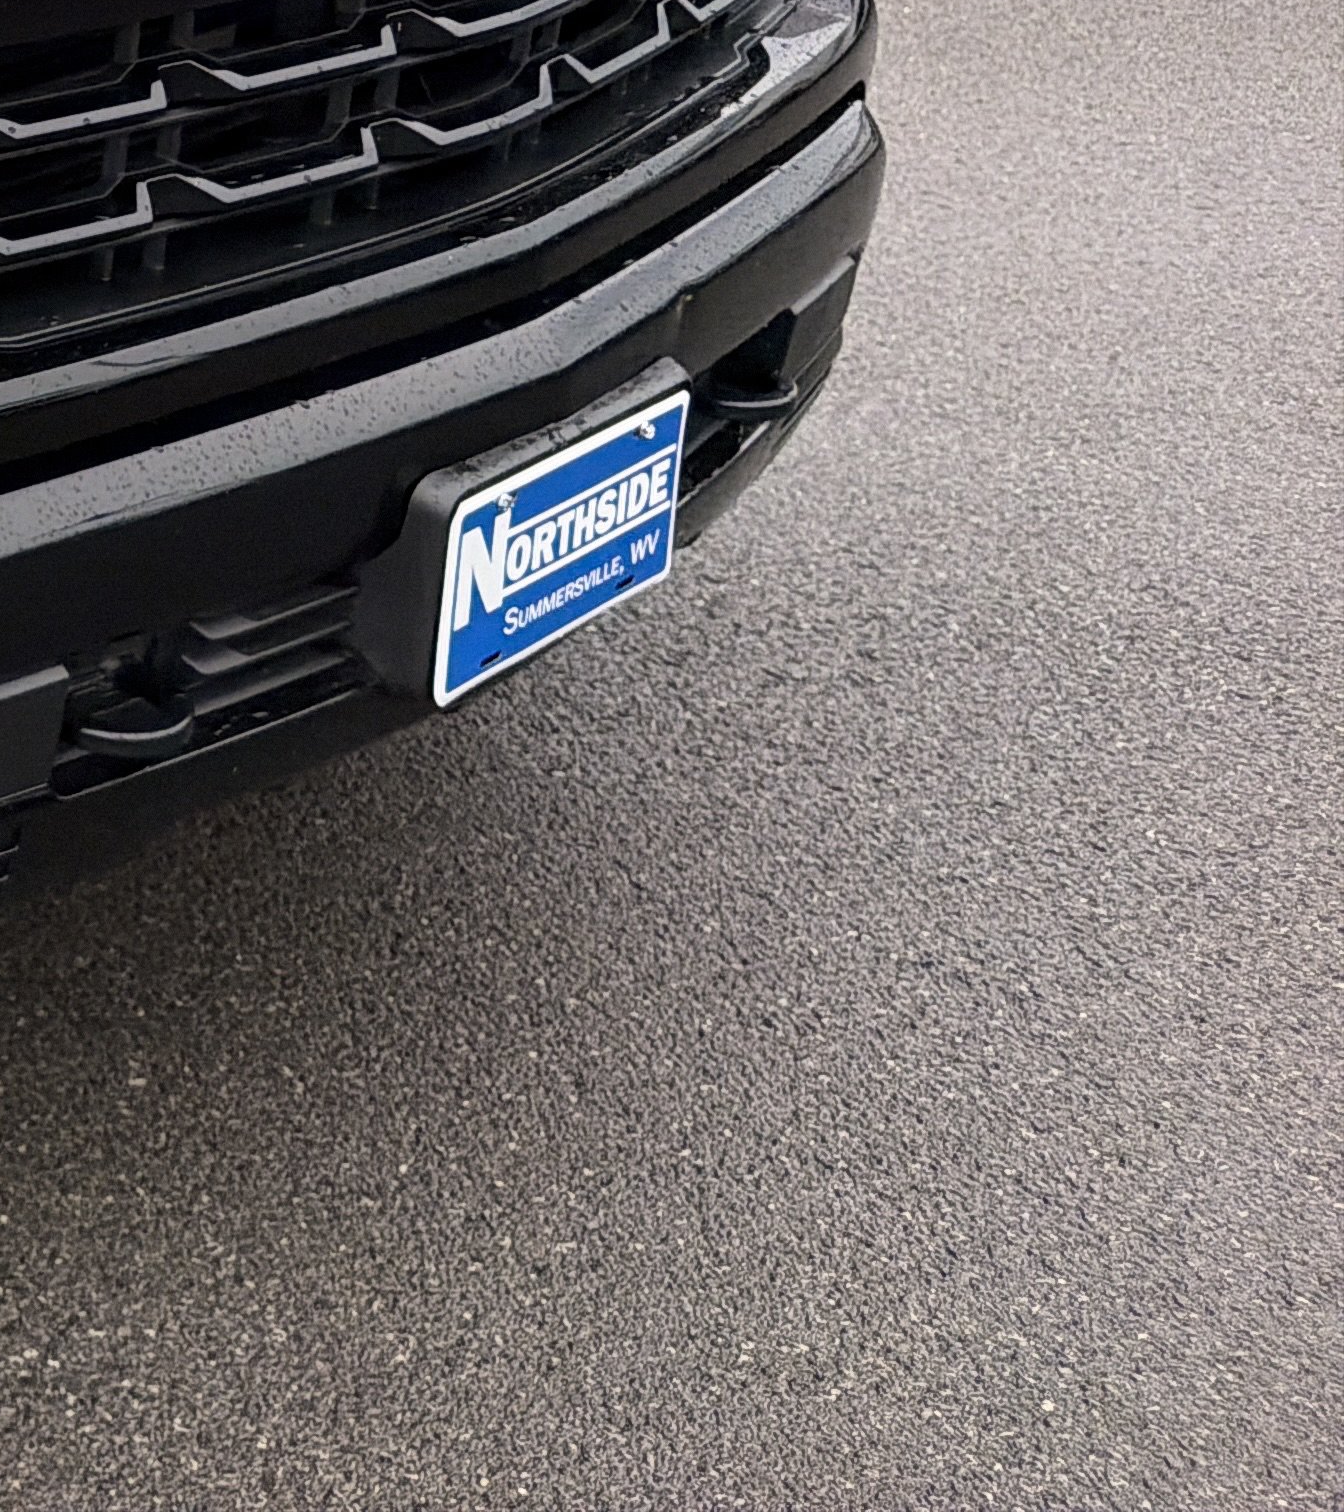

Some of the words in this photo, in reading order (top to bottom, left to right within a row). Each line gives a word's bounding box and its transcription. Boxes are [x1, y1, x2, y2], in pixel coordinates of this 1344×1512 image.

[453, 458, 671, 632] NORTHSIDE
[502, 555, 625, 636] SUMMERSVILLE,
[630, 528, 660, 564] WV
